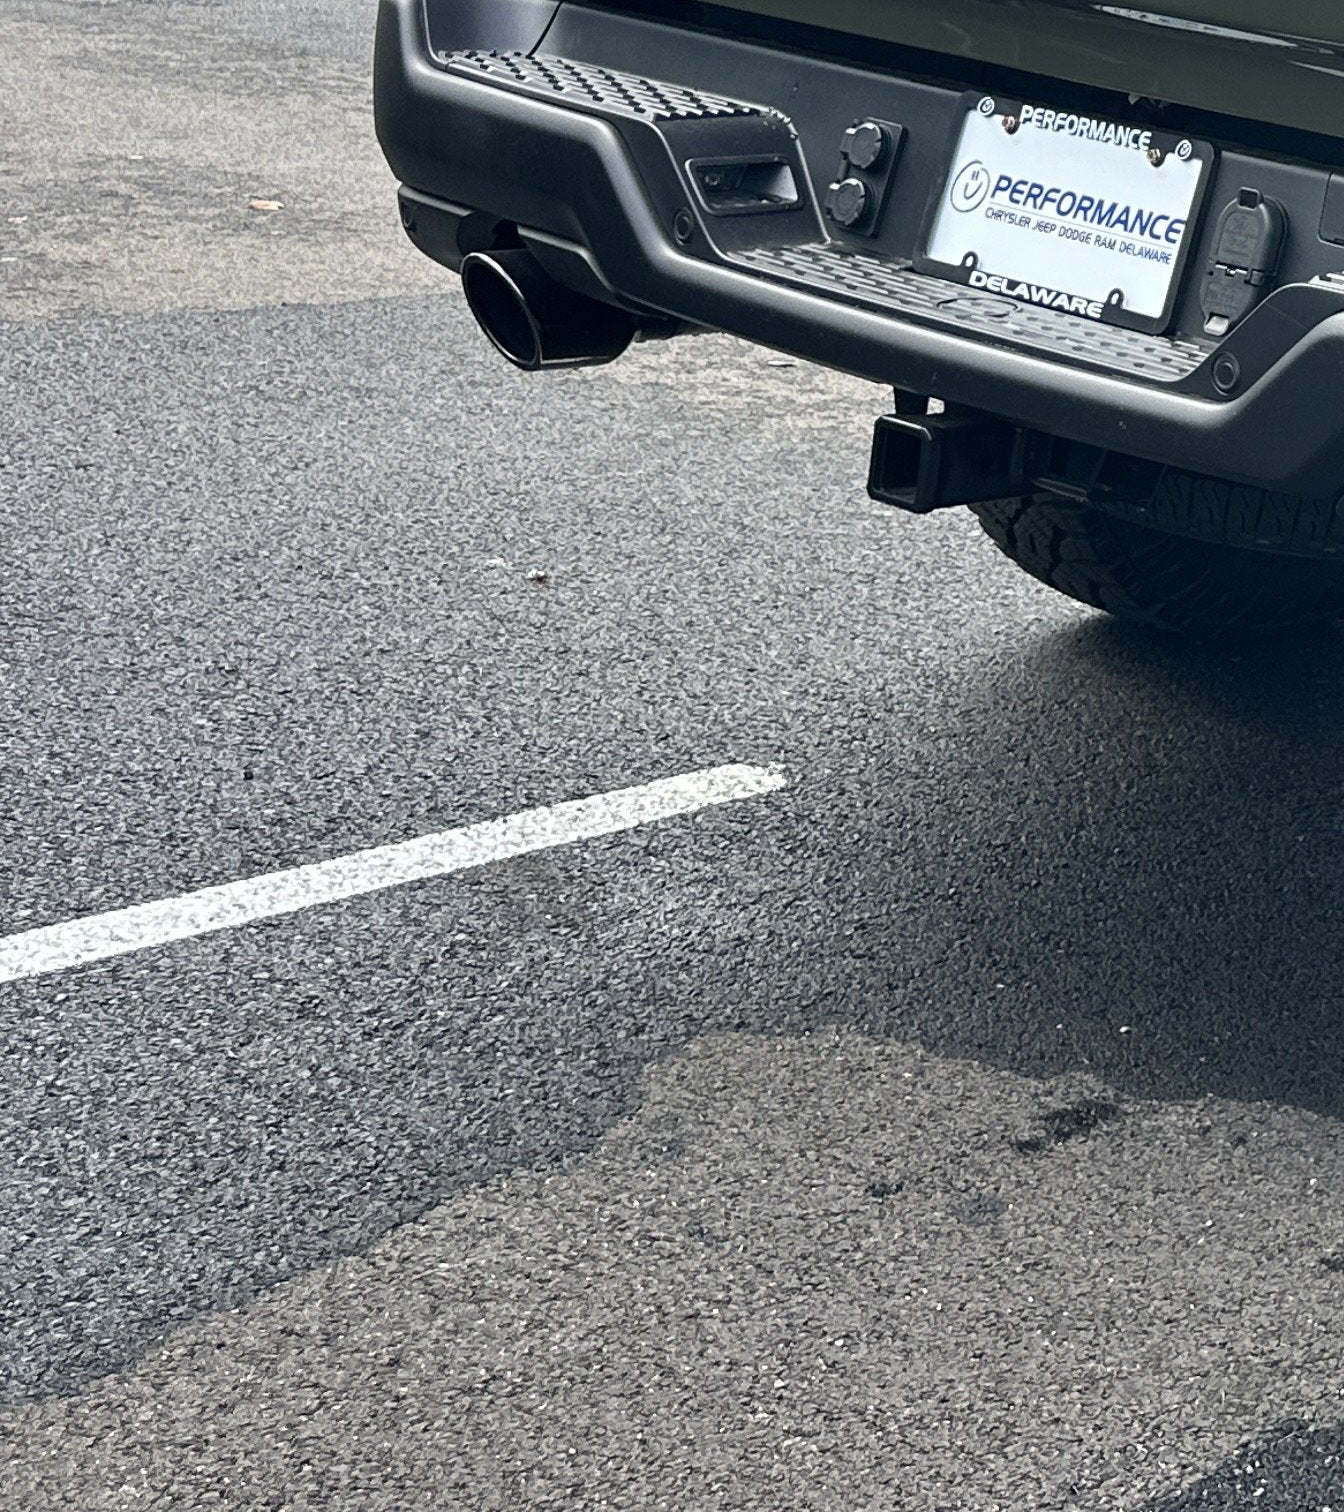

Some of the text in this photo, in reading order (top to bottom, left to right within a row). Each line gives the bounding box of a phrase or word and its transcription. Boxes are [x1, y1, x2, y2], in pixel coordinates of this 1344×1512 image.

[1019, 104, 1152, 151] PERFORMANCE
[985, 207, 1172, 265] CHRYSLER JEEP DODGE RAM DELAWARE
[990, 175, 1187, 244] PERFORMANCE
[969, 269, 1105, 319] DELAWARE
